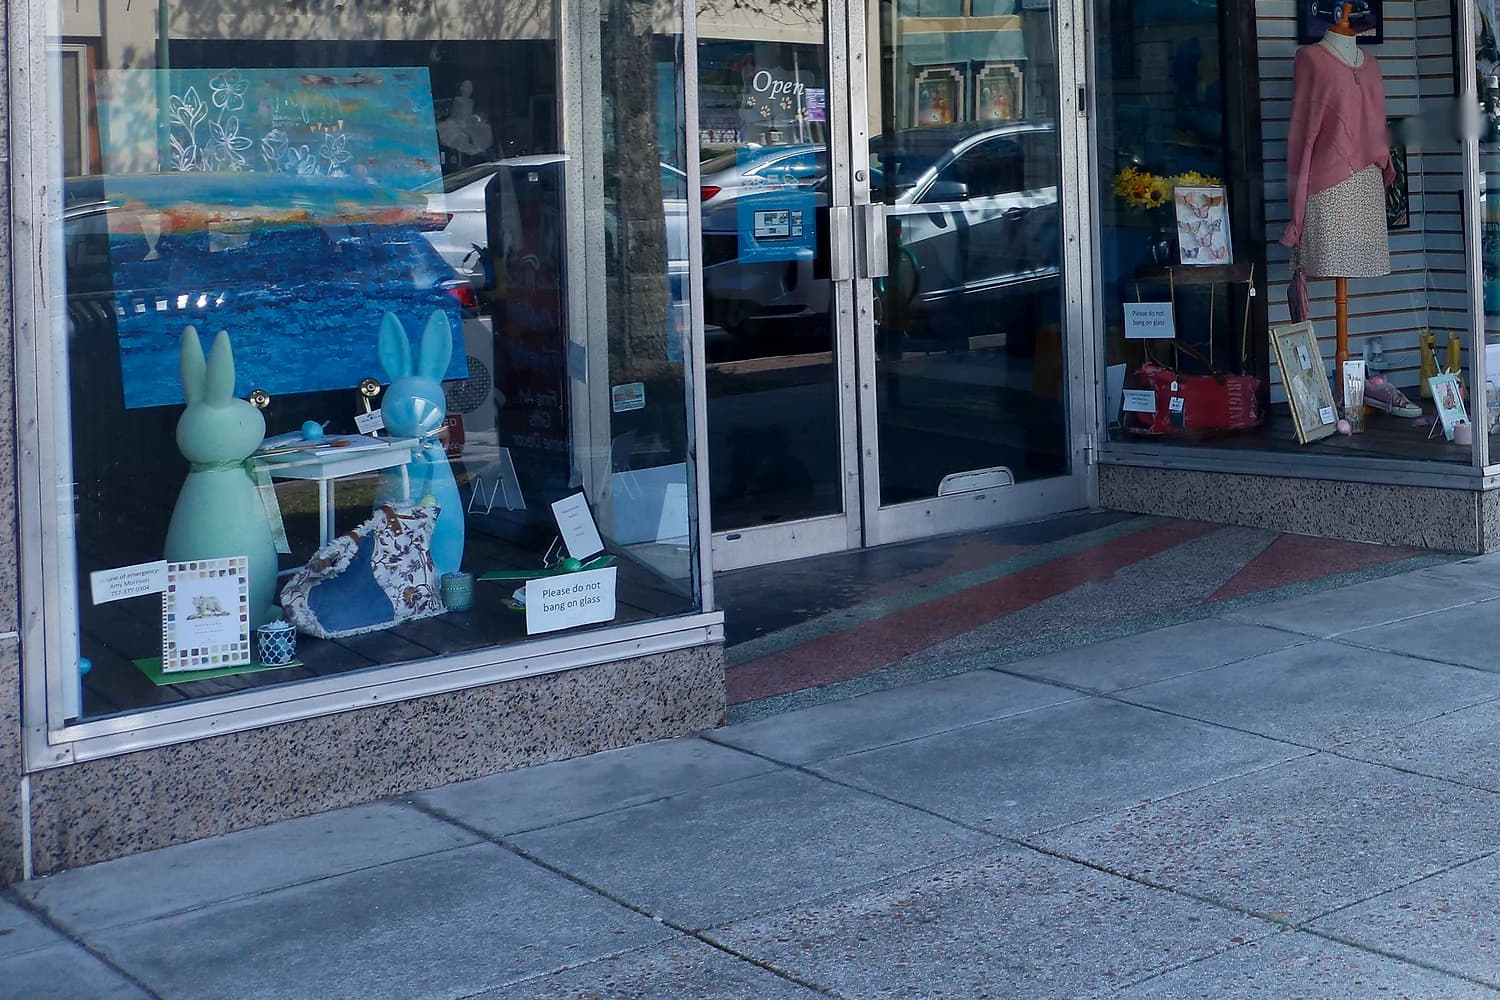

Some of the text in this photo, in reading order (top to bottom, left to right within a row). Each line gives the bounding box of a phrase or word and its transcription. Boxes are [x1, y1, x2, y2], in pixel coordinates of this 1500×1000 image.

[753, 70, 805, 100] Open
[542, 581, 601, 598] Please do not
[543, 595, 601, 612] bang on glass
